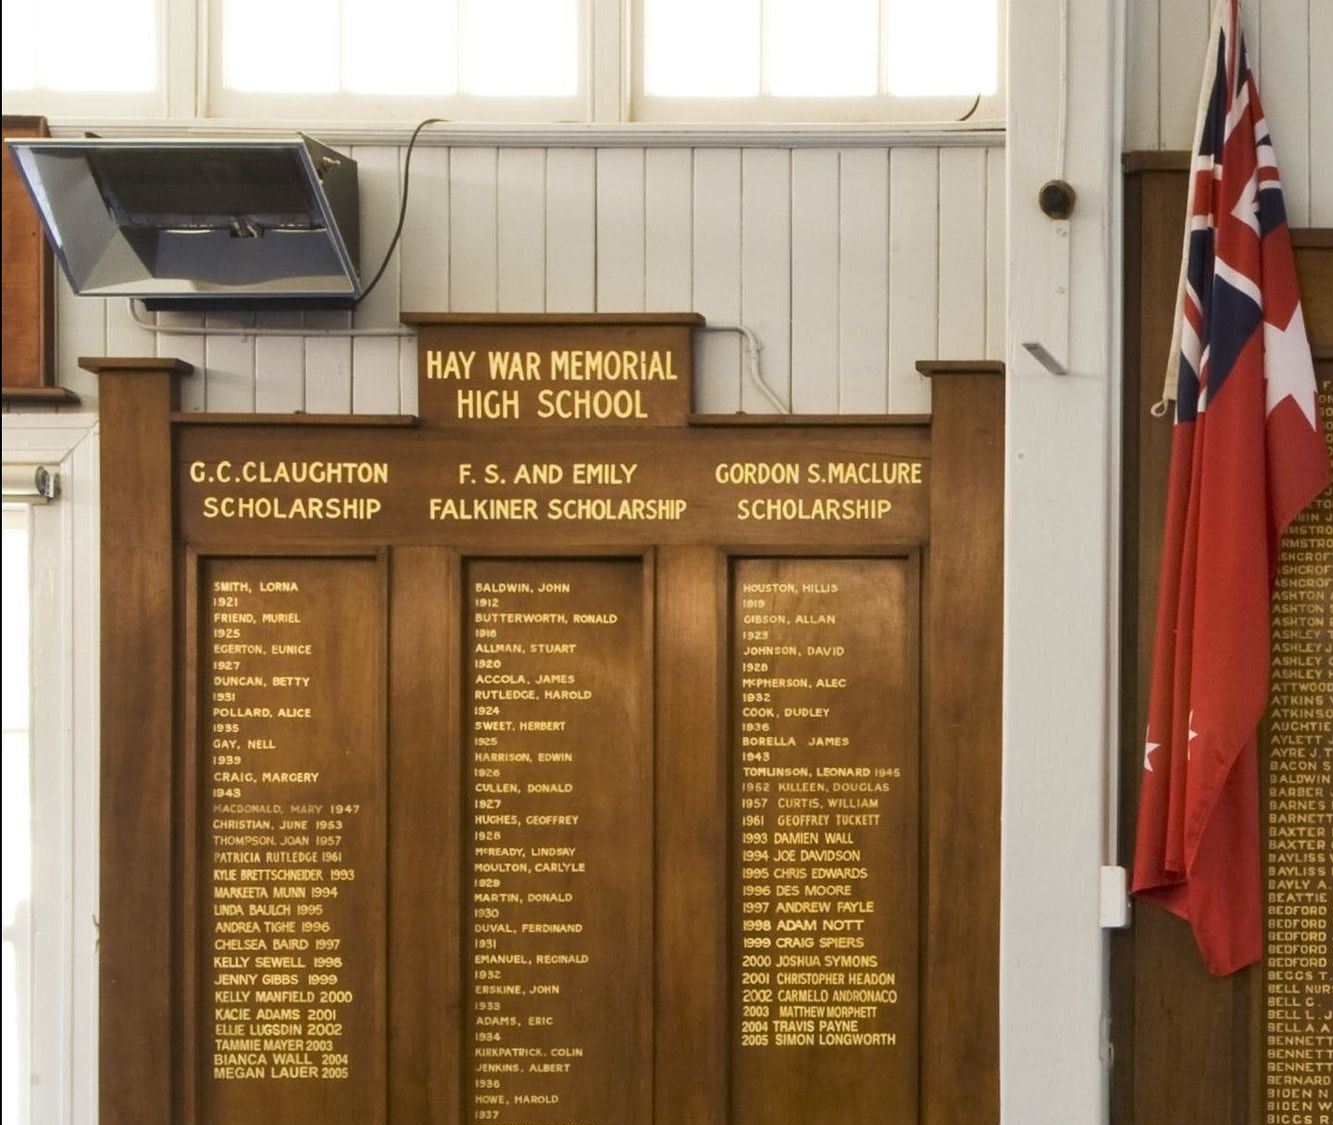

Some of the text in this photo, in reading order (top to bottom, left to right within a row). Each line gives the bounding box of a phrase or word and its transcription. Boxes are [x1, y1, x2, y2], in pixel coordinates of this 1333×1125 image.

[427, 351, 677, 380] HAY WAR MEMORIAL
[458, 390, 647, 418] HIGH SCHOOL
[460, 464, 637, 484] F. S. AND EMILY
[716, 463, 921, 484] GORDON S.MACLURE
[204, 497, 380, 519] SCHOLARSHIP
[430, 499, 686, 520] FALKINER SCHOLARSHIP
[738, 499, 891, 520] SCHOLARSHIP
[215, 582, 298, 593] SMITH, LORNA
[476, 583, 569, 593] BALDWIN, JOHN
[214, 597, 238, 607] 1921
[476, 598, 498, 607] 1912
[214, 613, 300, 623] FRIEND, MURIEL
[476, 614, 617, 624] BUTTERWORTH, RONALD
[536, 675, 574, 684] JAMES
[743, 693, 770, 702] 1932
[785, 708, 829, 717] DUDLEY
[248, 740, 275, 749] NELL
[743, 833, 853, 844] 1993 DAMIEN WALL
[475, 893, 572, 903] MARTIN, DONALD
[475, 908, 499, 918] 1930
[216, 922, 330, 933] ANDREA TIGHE 1996
[744, 920, 864, 931] 1998 ADAM NOTT
[214, 957, 342, 968] KELLY SEWELL 1998
[743, 955, 877, 967] 2000 JOSHUA SYMONS
[1268, 984, 1300, 993] BELL
[742, 1034, 895, 1045] 2005 SIMON LONGWORTH
[214, 1053, 348, 1067] BIANCA WALL 2004
[215, 1066, 348, 1078] MEGAN LAUER 2005
